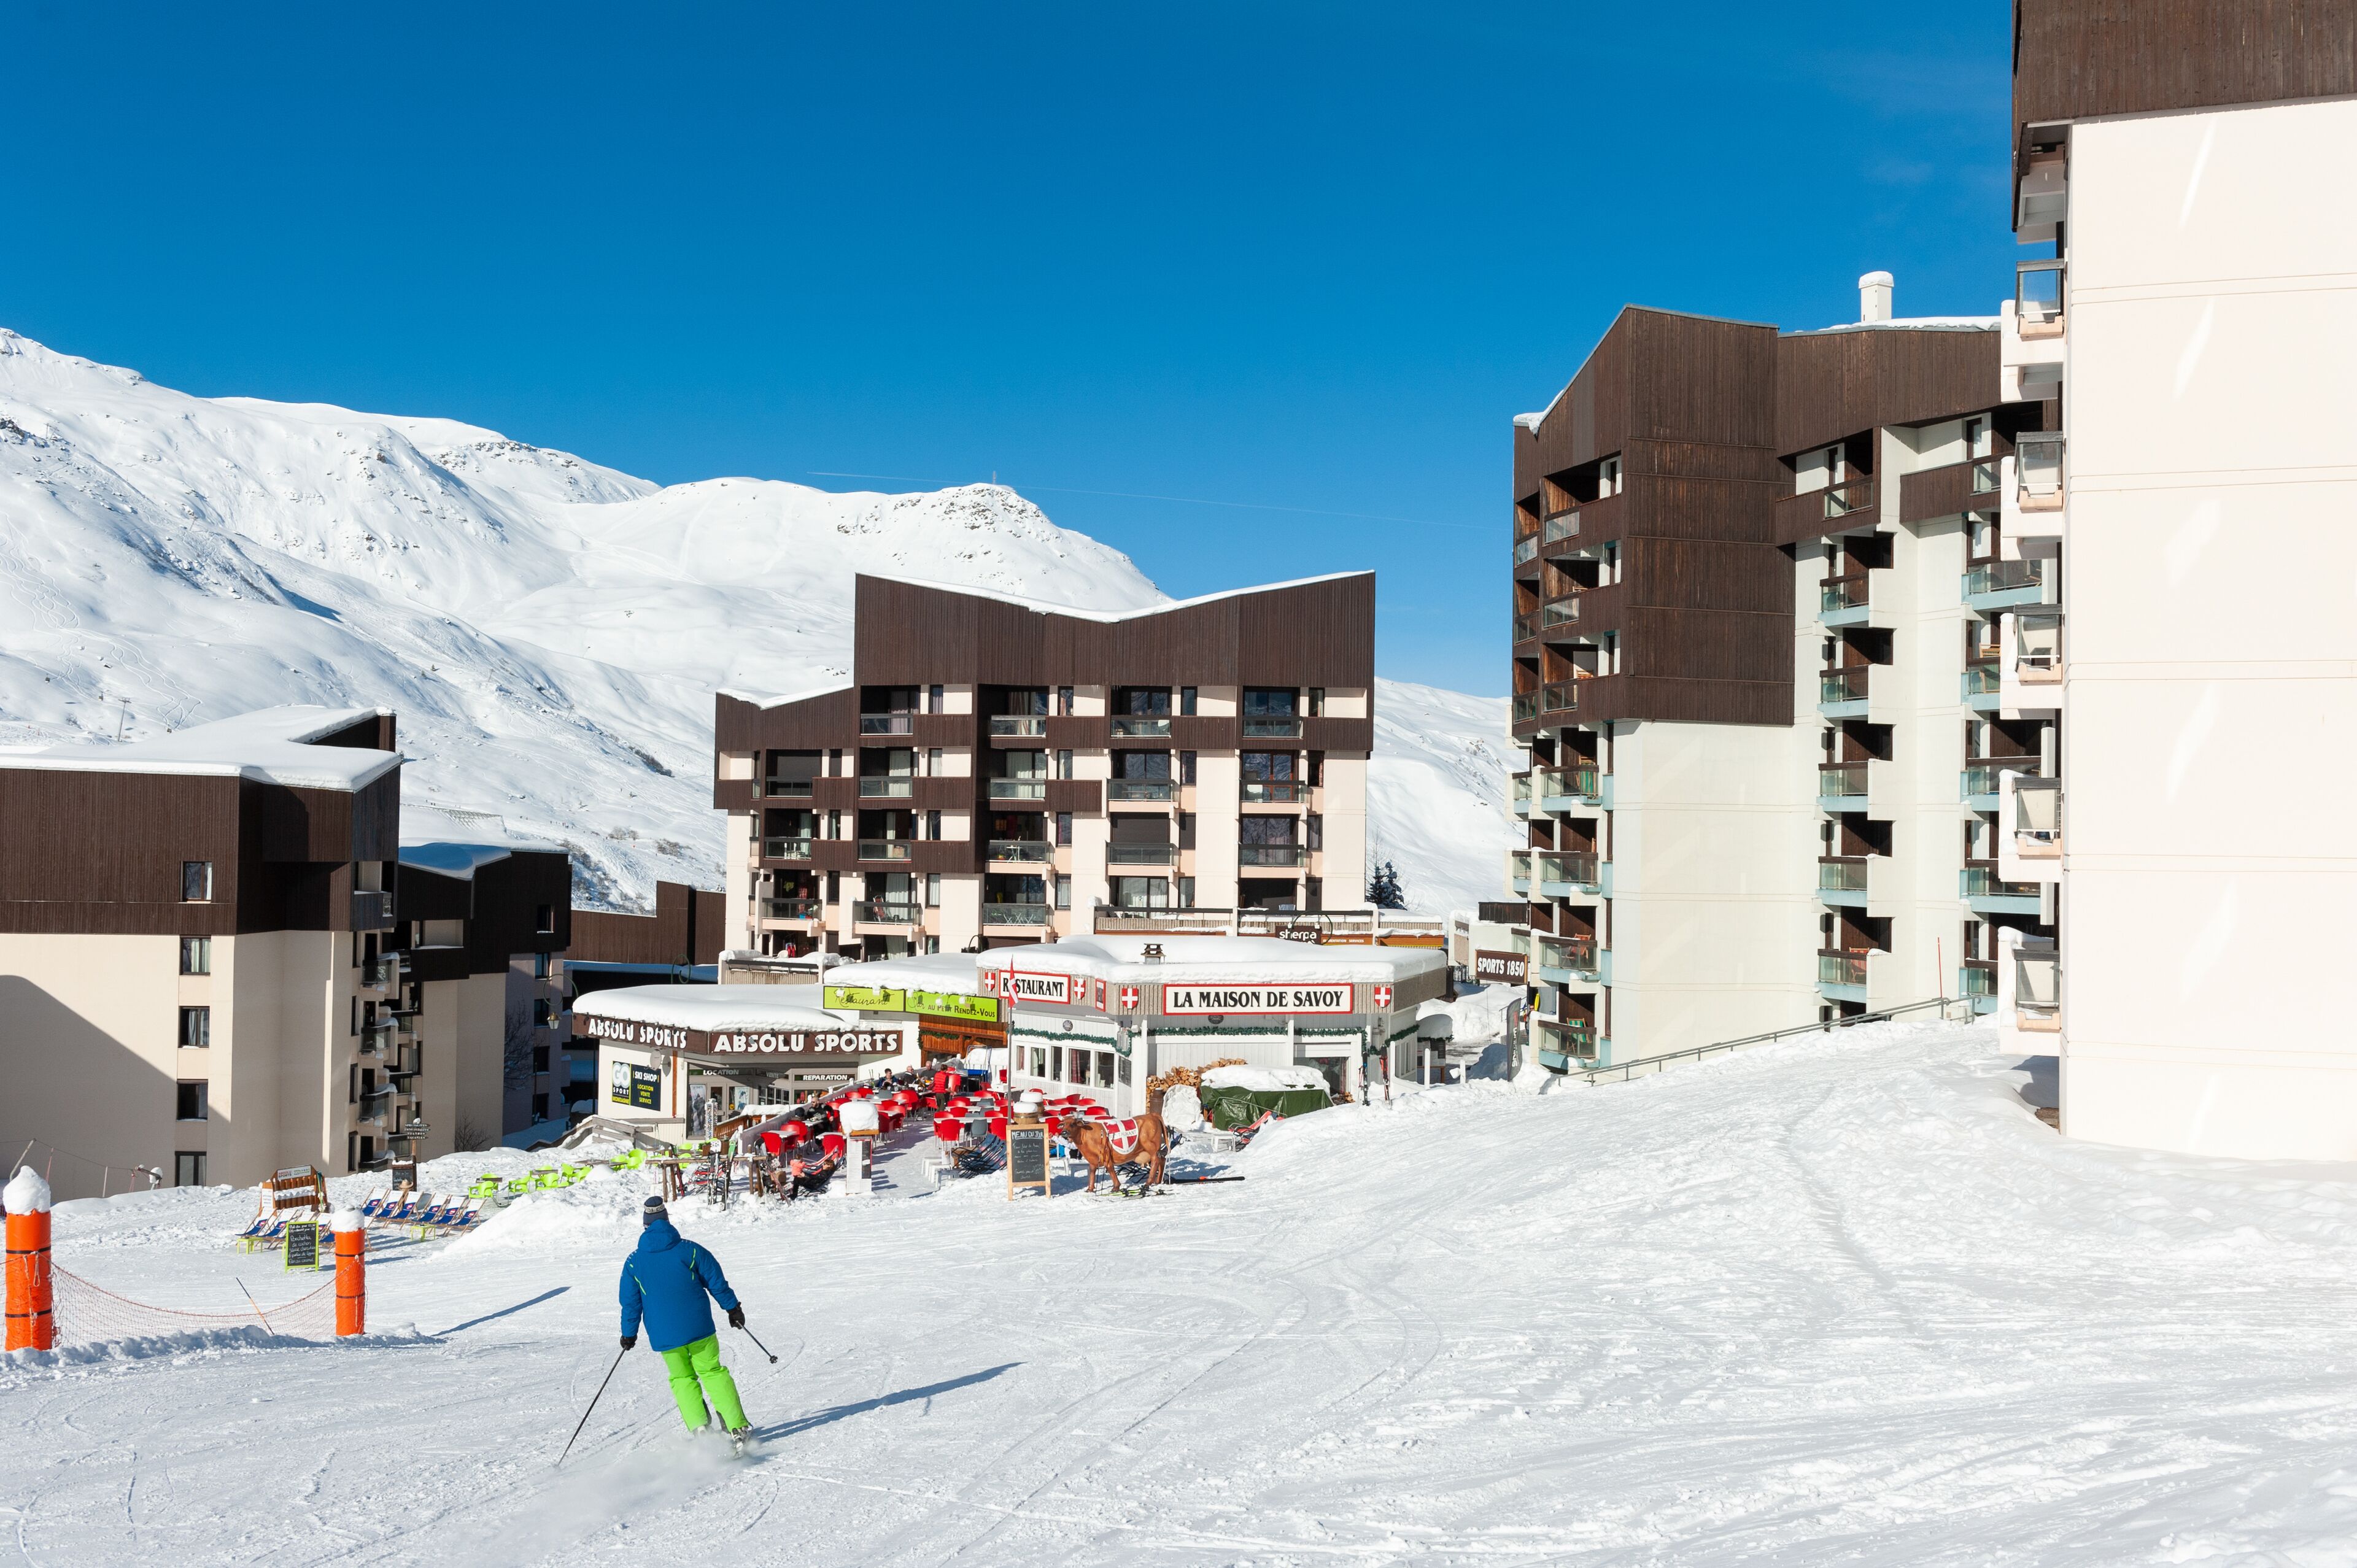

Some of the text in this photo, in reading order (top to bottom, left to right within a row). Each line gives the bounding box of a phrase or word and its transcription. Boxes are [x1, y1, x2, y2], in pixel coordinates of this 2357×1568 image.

[1279, 929, 1317, 941] sherpa
[1477, 957, 1525, 977] SPORTS 1850
[1002, 977, 1064, 997] RSTAURANT
[1173, 991, 1344, 1008] LA MAISON DE SAVOY
[588, 1018, 687, 1049] ABSOLU SPORTS
[713, 1033, 897, 1052] ABSOLU SPORTS
[613, 1062, 630, 1089] GO
[643, 1072, 657, 1083] SHOP
[1012, 1131, 1028, 1140] MENU
